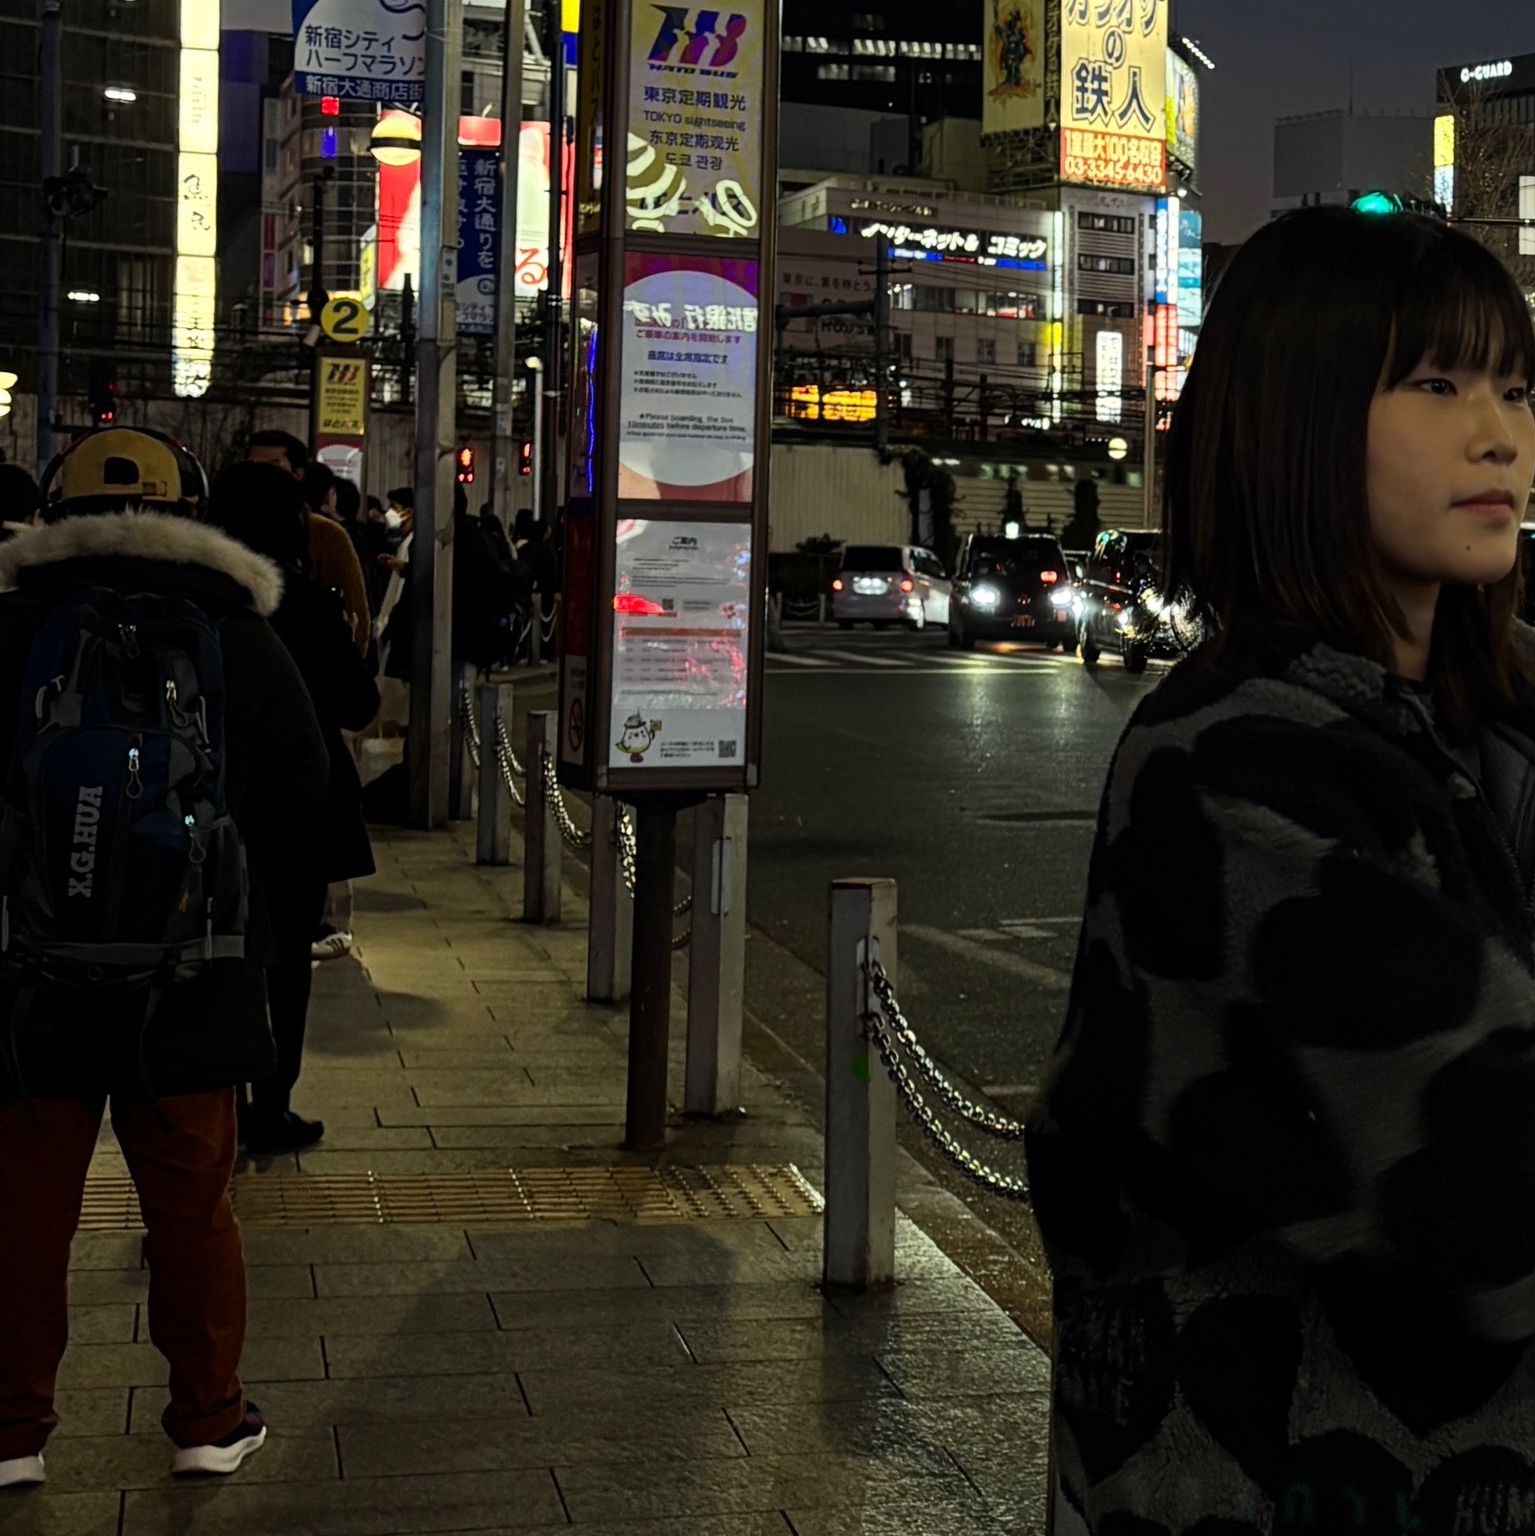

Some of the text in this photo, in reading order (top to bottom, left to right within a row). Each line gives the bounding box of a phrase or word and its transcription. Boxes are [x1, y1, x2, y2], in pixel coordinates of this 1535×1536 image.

[305, 24, 395, 53] 新宿シティ
[1104, 27, 1125, 68] の
[648, 63, 738, 79] HATO BUS
[643, 86, 746, 111] 東京定期観光
[1072, 60, 1155, 132] 鉄人
[643, 110, 746, 131] TOKYO sightseeing
[649, 131, 740, 152] 东京定期观光
[665, 153, 723, 171] 도쿄 관광
[1064, 156, 1162, 184] 03-3345-6430
[473, 158, 497, 269] 新宿大通りを
[332, 300, 359, 335] 2
[67, 785, 103, 898] X.G.HUA
